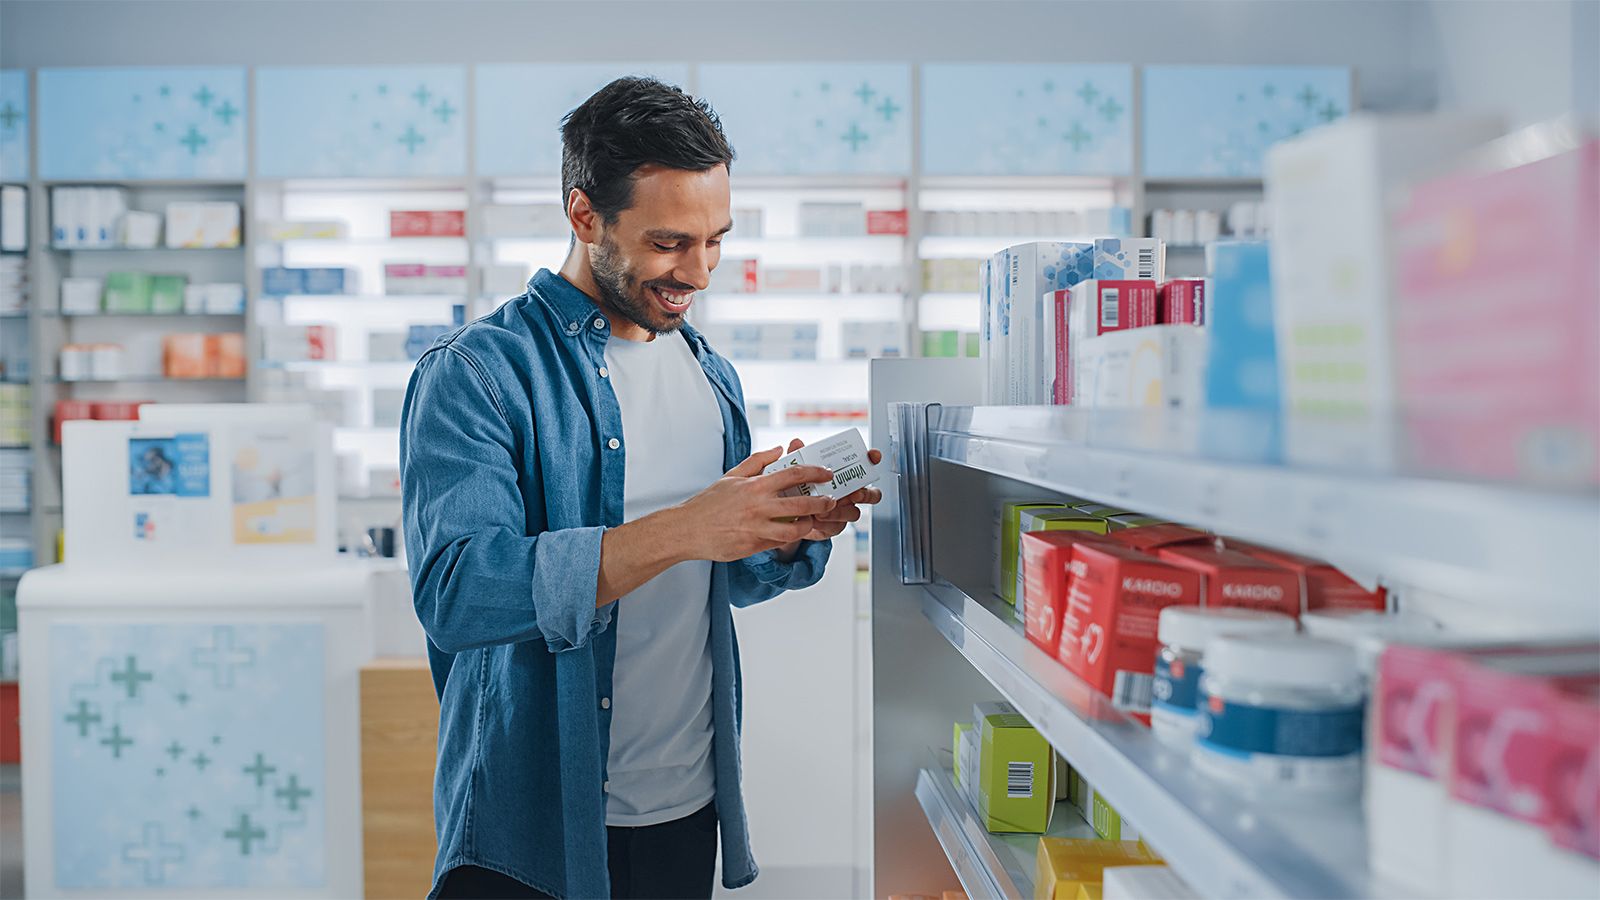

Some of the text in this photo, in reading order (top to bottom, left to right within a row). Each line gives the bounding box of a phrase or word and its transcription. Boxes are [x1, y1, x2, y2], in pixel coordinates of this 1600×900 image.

[835, 464, 867, 487] Vitamin
[1122, 577, 1182, 597] KARDIO
[1222, 583, 1283, 601] KARDIO
